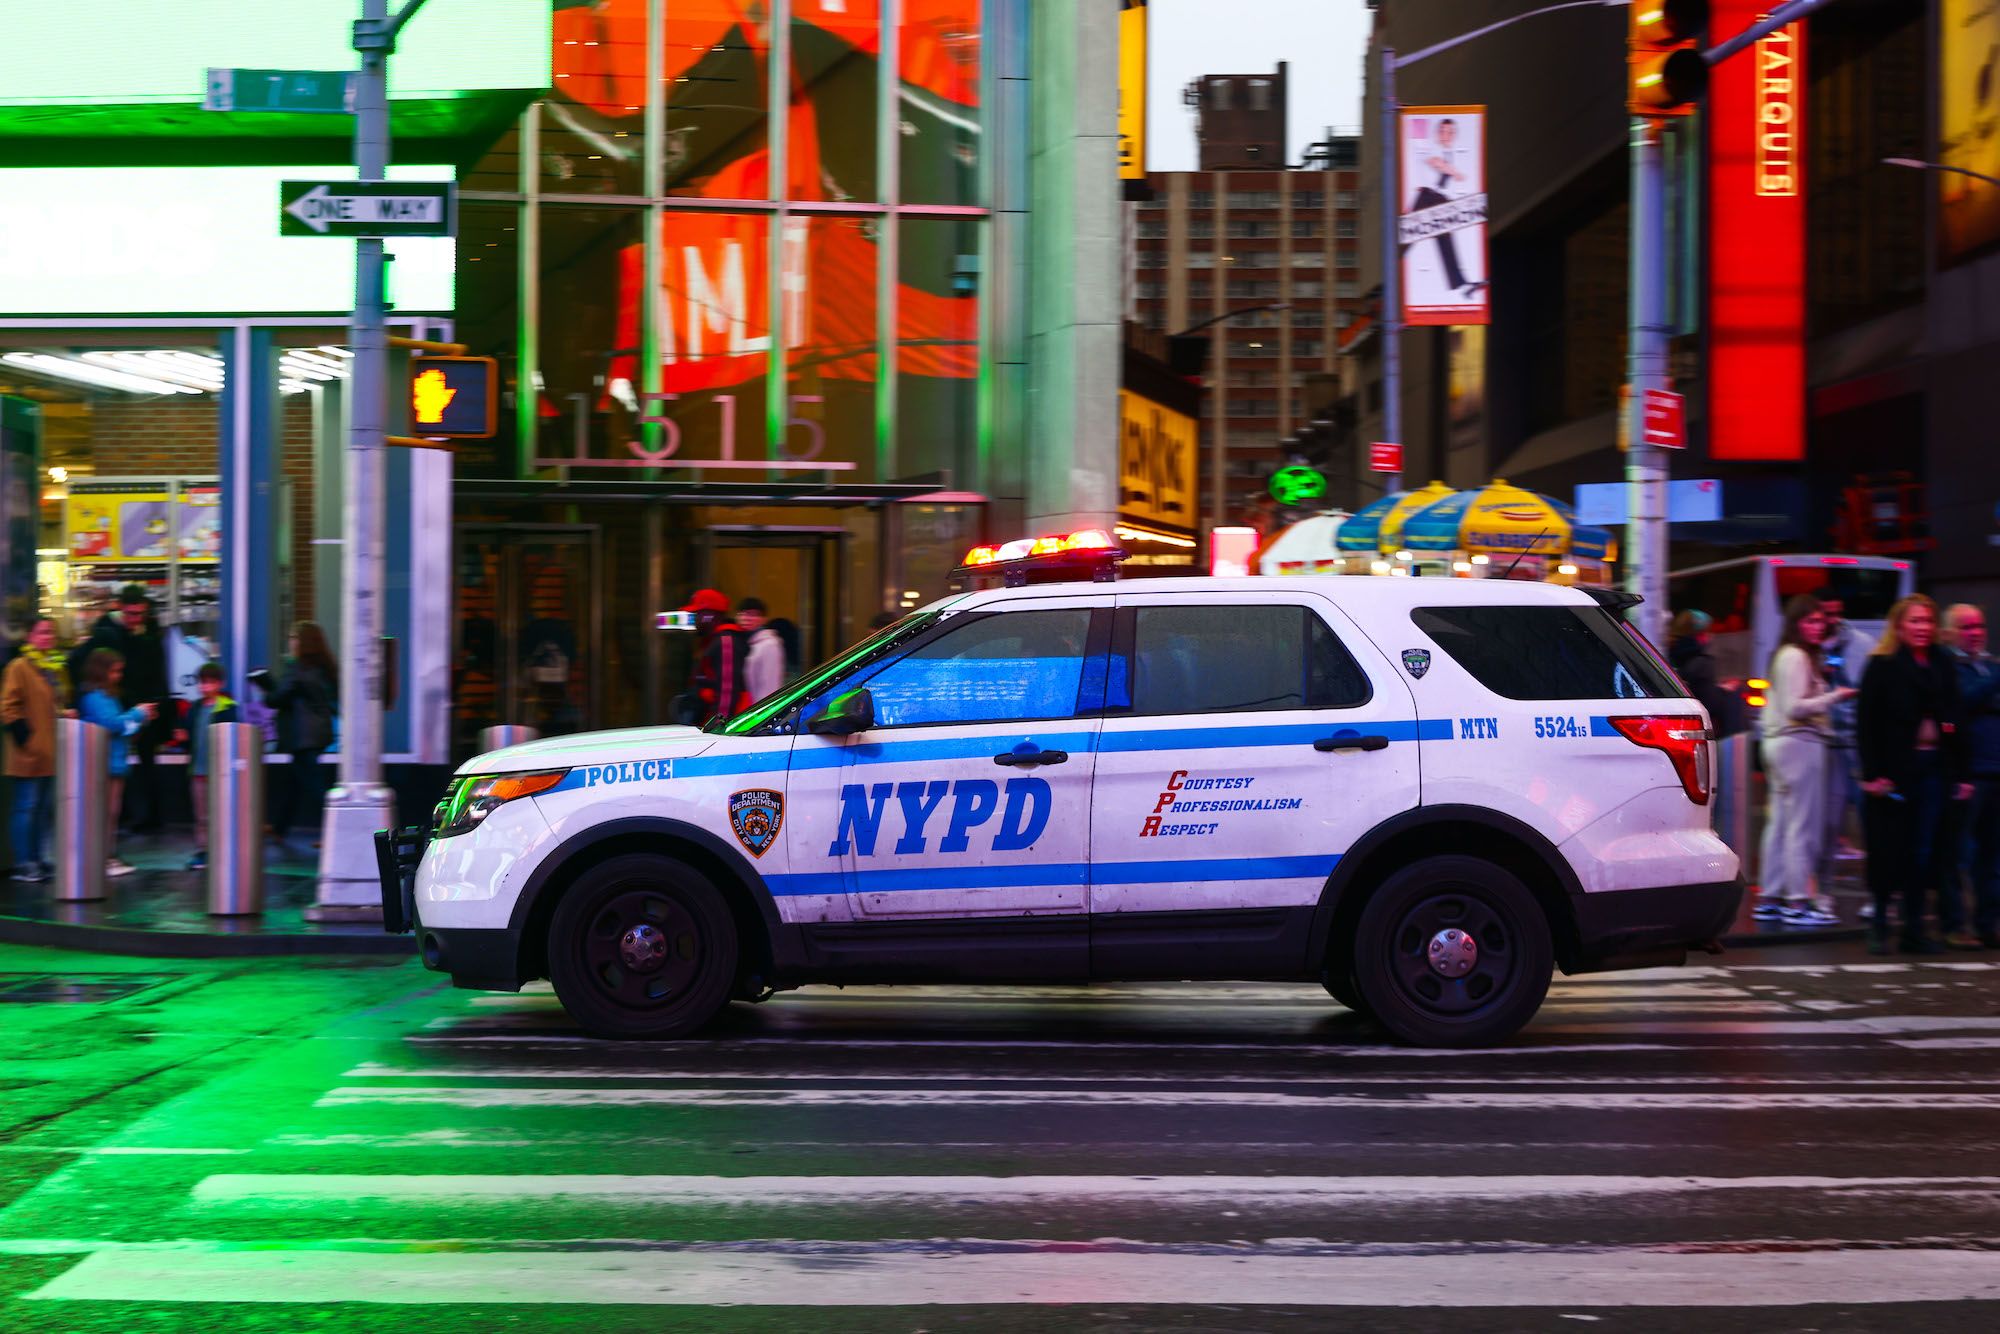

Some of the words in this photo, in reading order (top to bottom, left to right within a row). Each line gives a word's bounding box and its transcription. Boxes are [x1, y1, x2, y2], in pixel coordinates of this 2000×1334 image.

[301, 198, 355, 220] ONE
[376, 198, 431, 220] WAY
[556, 393, 826, 461] 1515
[1459, 718, 1498, 739] MTN
[1534, 716, 1577, 738] 5524
[588, 760, 671, 787] POLICE
[731, 798, 781, 812] DEPARTMENT
[741, 791, 770, 801] POLICE
[828, 777, 1052, 857] NYPD
[733, 818, 744, 835] CITY
[742, 836, 752, 846] OF
[762, 834, 773, 849] NEW
[771, 813, 781, 832] YORK
